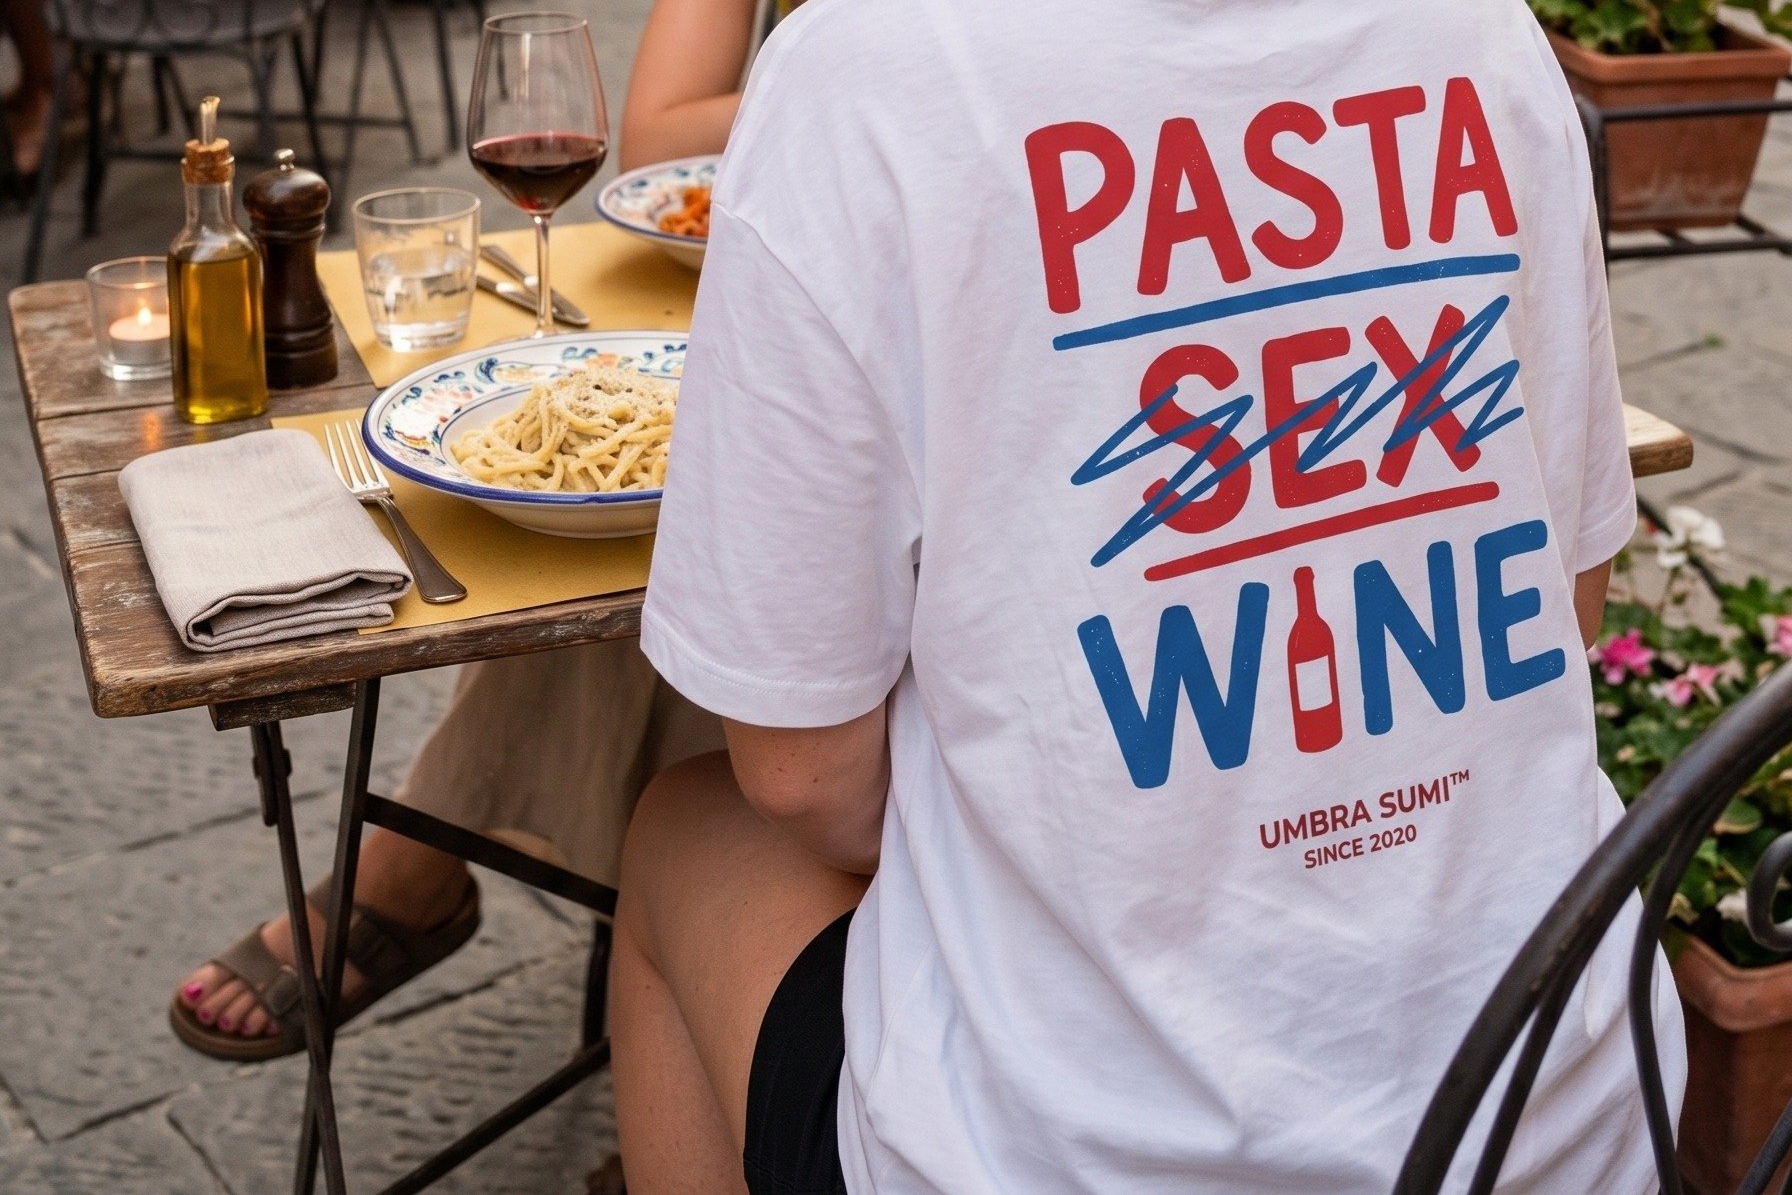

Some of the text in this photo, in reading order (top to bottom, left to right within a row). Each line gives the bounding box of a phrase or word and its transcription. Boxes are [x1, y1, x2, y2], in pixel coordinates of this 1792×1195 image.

[1024, 76, 1519, 314] PASTA
[1138, 303, 1482, 535] SEX
[1076, 519, 1566, 790] WINE
[1259, 799, 1372, 849] UMBRA
[1304, 824, 1418, 869] SINCE 2020
